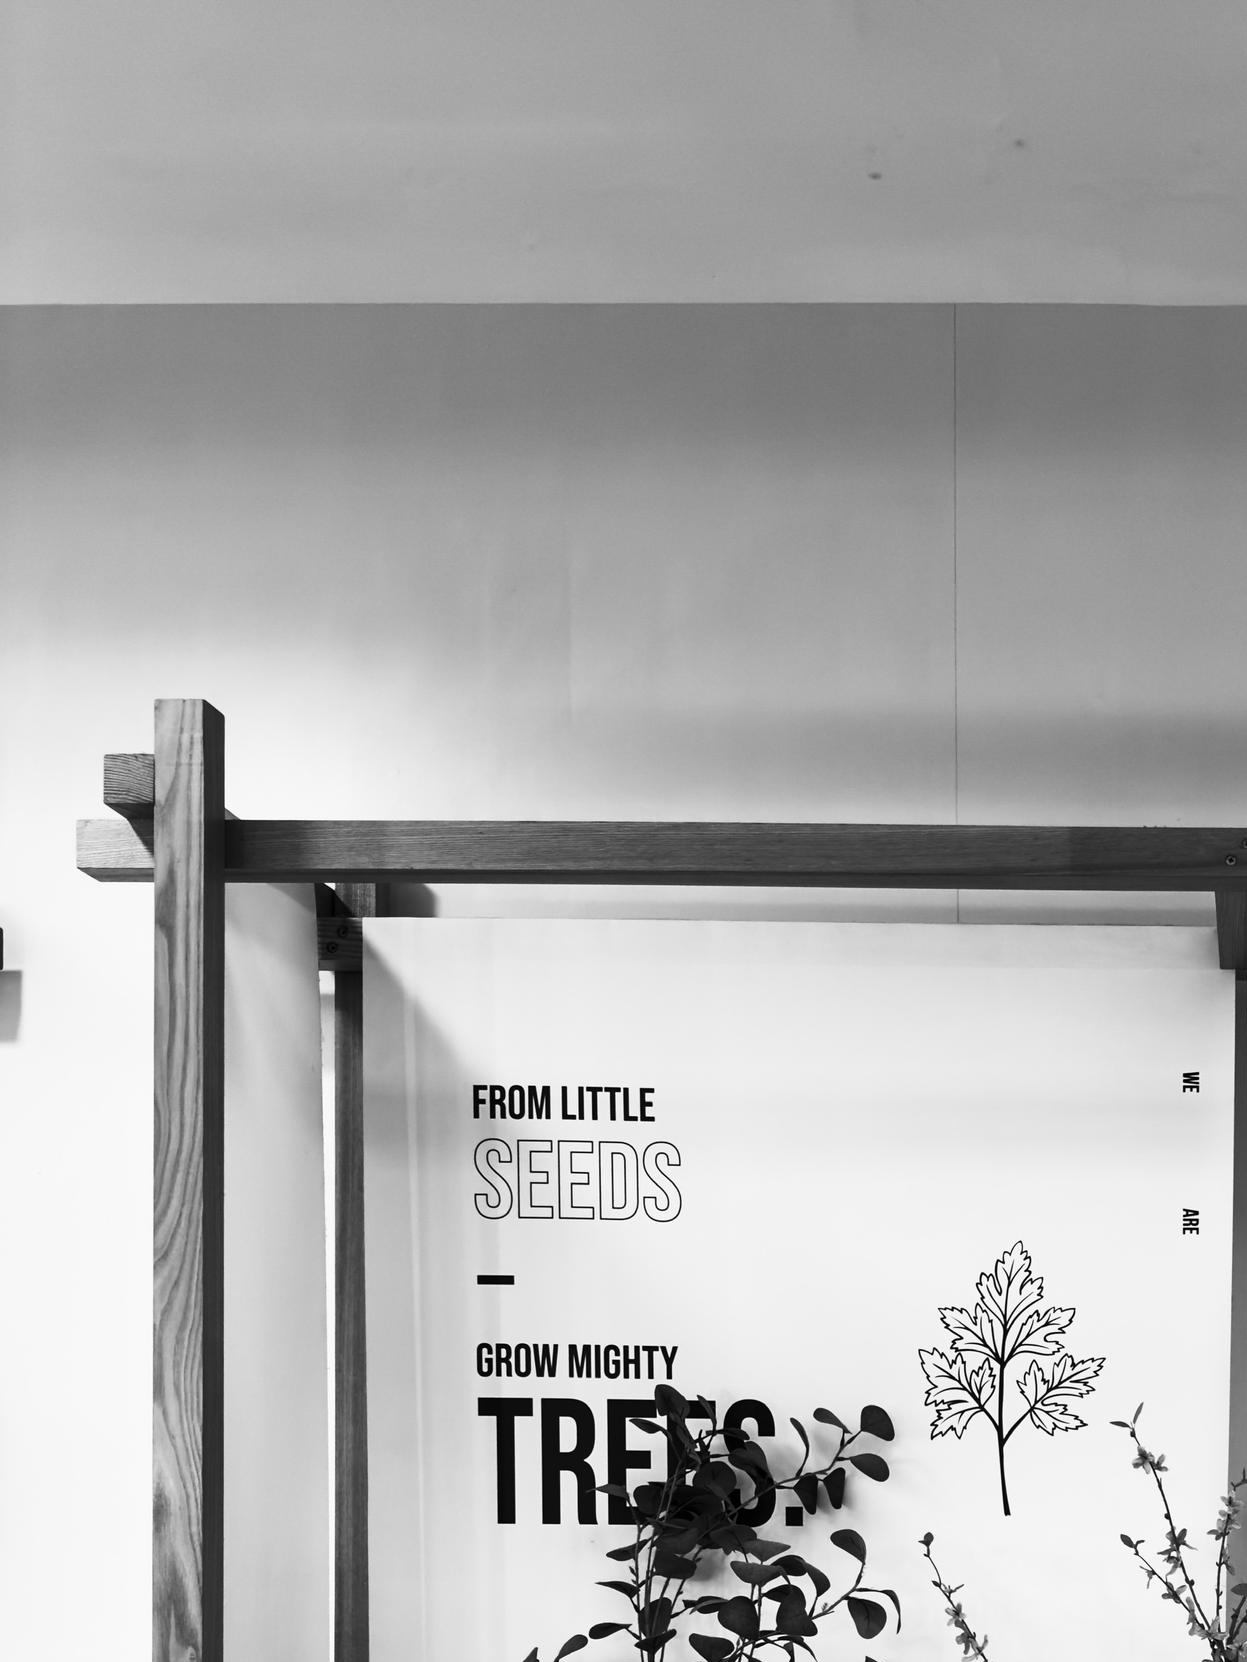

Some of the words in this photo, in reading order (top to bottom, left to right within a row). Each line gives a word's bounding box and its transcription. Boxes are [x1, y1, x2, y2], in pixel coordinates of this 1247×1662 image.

[1182, 1071, 1200, 1093] WE
[472, 1084, 552, 1120] FROM
[560, 1085, 656, 1122] LITTLE
[473, 1137, 683, 1223] SEEDS
[1182, 1208, 1200, 1235] ARE
[475, 1342, 559, 1378] GROW
[567, 1343, 679, 1380] MIGHTY
